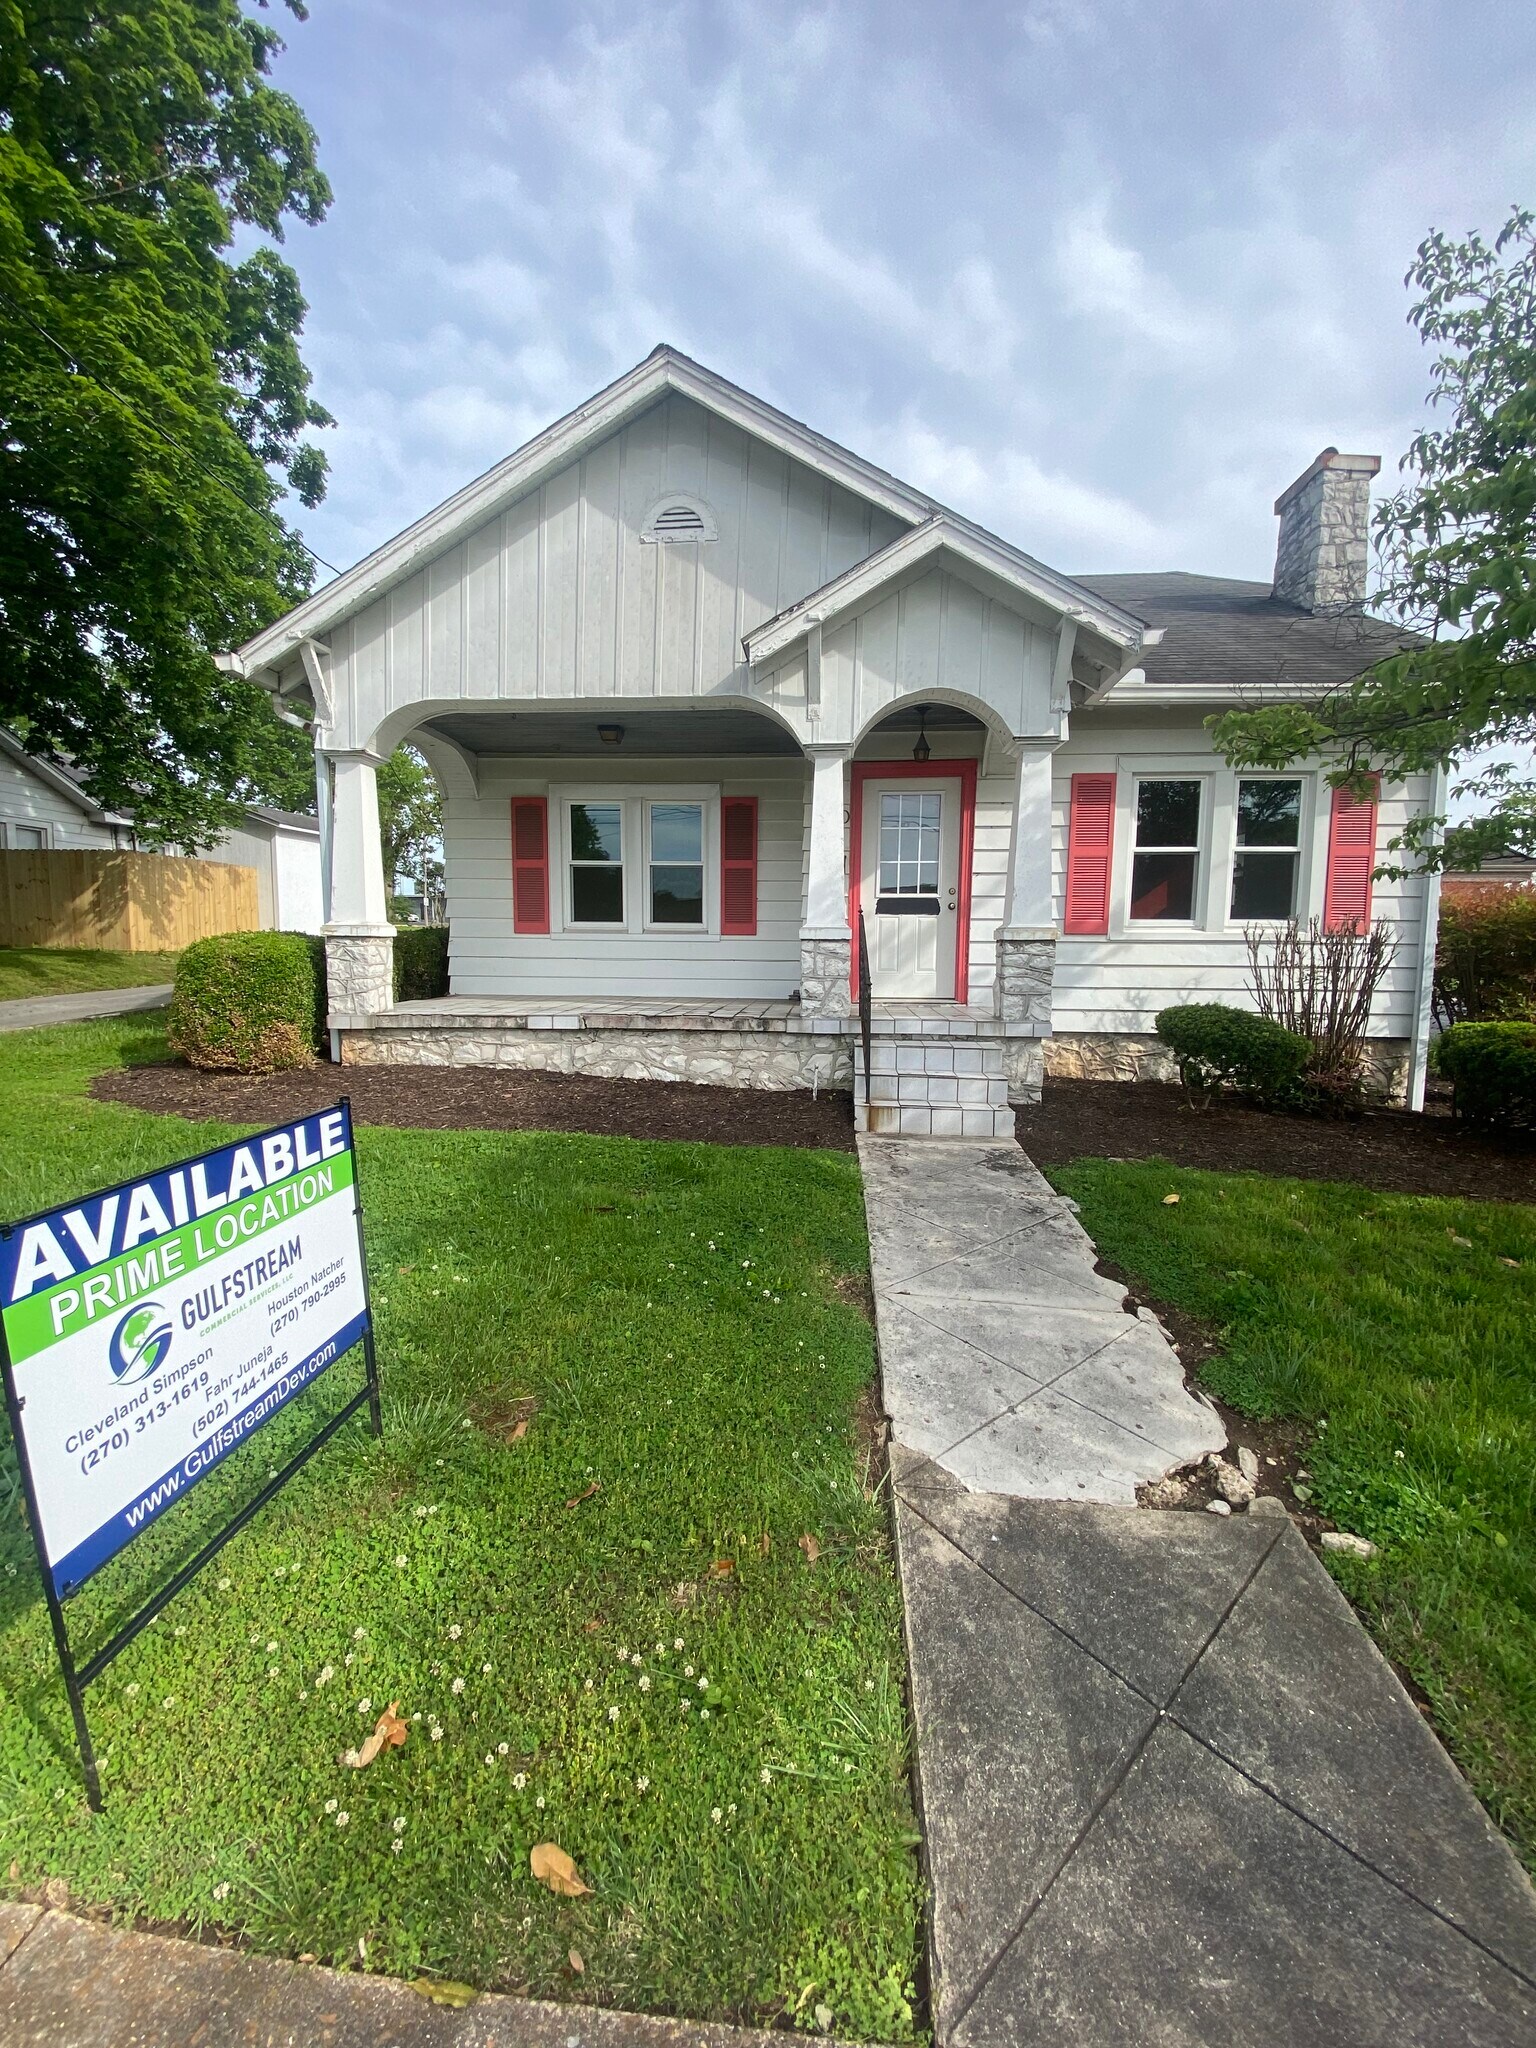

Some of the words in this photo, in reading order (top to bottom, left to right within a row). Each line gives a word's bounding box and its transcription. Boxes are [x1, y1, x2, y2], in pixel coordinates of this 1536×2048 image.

[11, 1111, 345, 1302] AVAILABLE
[49, 1236, 187, 1337] PRIME
[193, 1165, 334, 1263] LOCATION
[181, 1234, 303, 1331] GULFSTREAM
[199, 1303, 248, 1338] COMMERCIAL
[282, 1272, 294, 1285] LLC
[267, 1281, 309, 1316] Houston
[311, 1256, 344, 1288] Natcher
[270, 1306, 299, 1338] (270)
[302, 1271, 346, 1313] 790-2995
[65, 1387, 149, 1454] Cleveland
[153, 1347, 214, 1396] Simpson
[192, 1398, 229, 1439] (502)
[232, 1351, 289, 1404] 744-1465
[205, 1372, 234, 1402] Fahr
[237, 1345, 273, 1380] Juneja
[80, 1428, 130, 1476] (270)
[135, 1371, 209, 1434] 313-1619
[125, 1340, 337, 1528] www.GulfstreamDev.com
